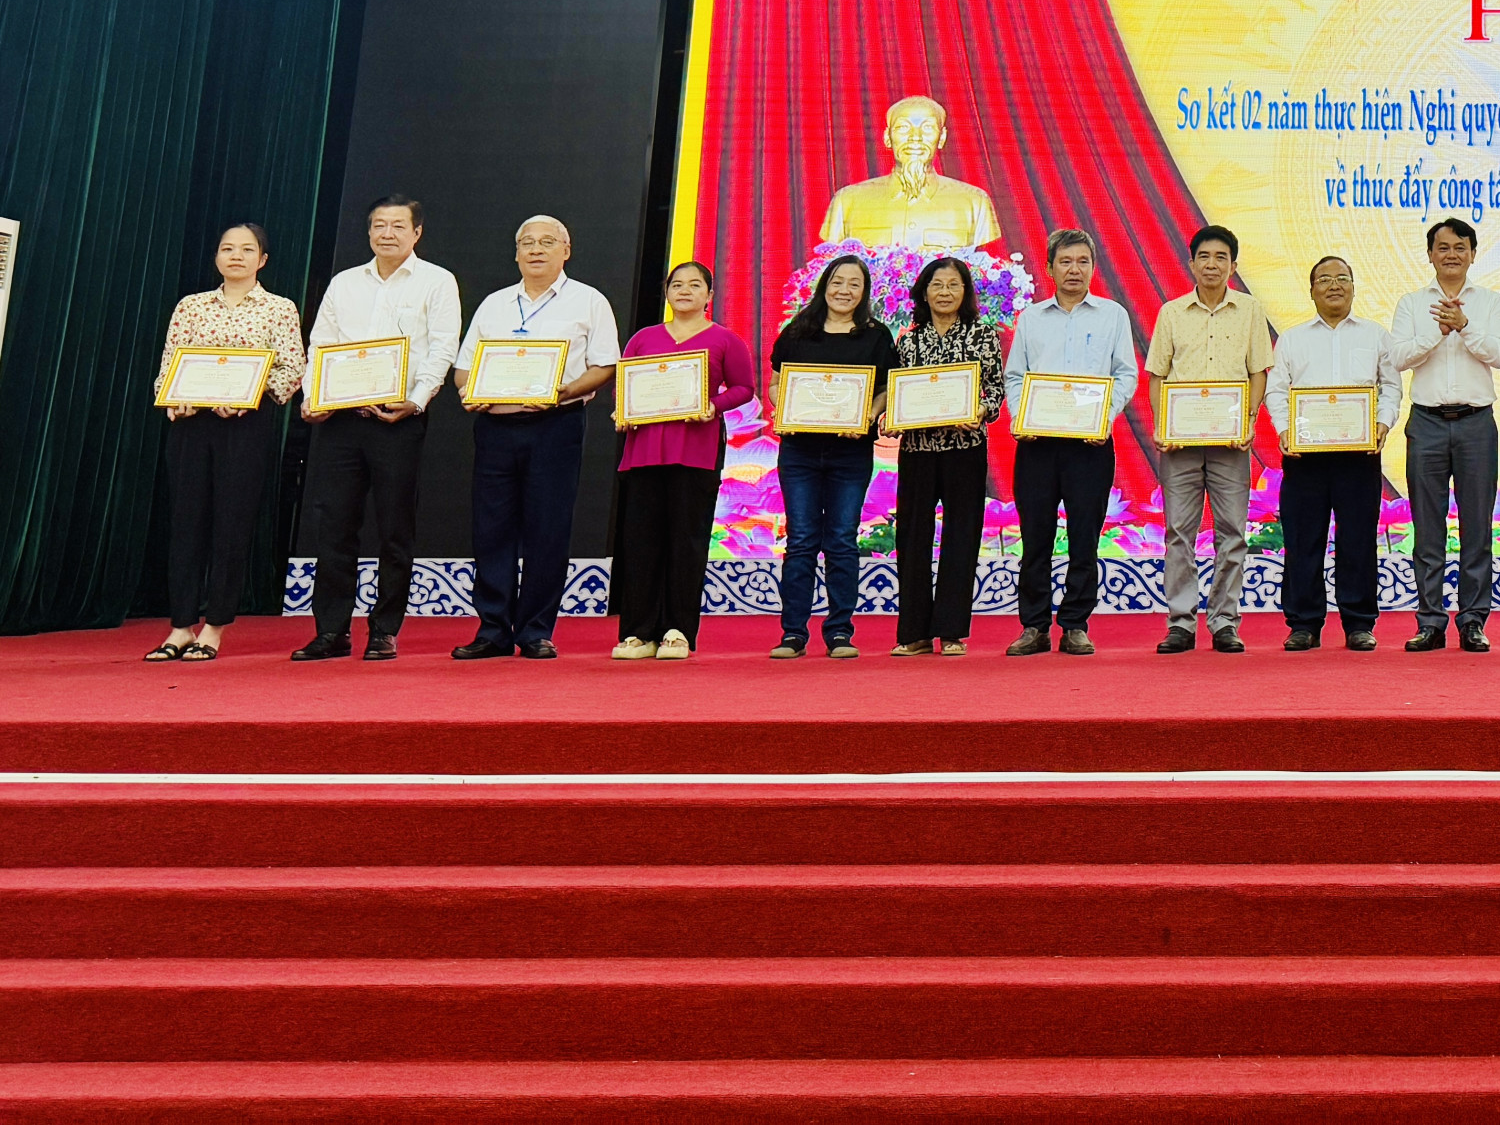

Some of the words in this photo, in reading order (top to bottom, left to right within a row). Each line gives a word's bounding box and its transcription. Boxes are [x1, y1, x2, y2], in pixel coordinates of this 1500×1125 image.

[1206, 80, 1237, 130] kết
[1242, 90, 1262, 130] 02
[1267, 89, 1309, 130] năm
[1314, 88, 1357, 140] thực
[1361, 88, 1403, 140] hiện
[1408, 88, 1456, 146] Nghị
[1325, 157, 1347, 208] về
[1352, 163, 1394, 208] thúc
[1399, 157, 1433, 223] đẩy
[1438, 164, 1484, 223] công
